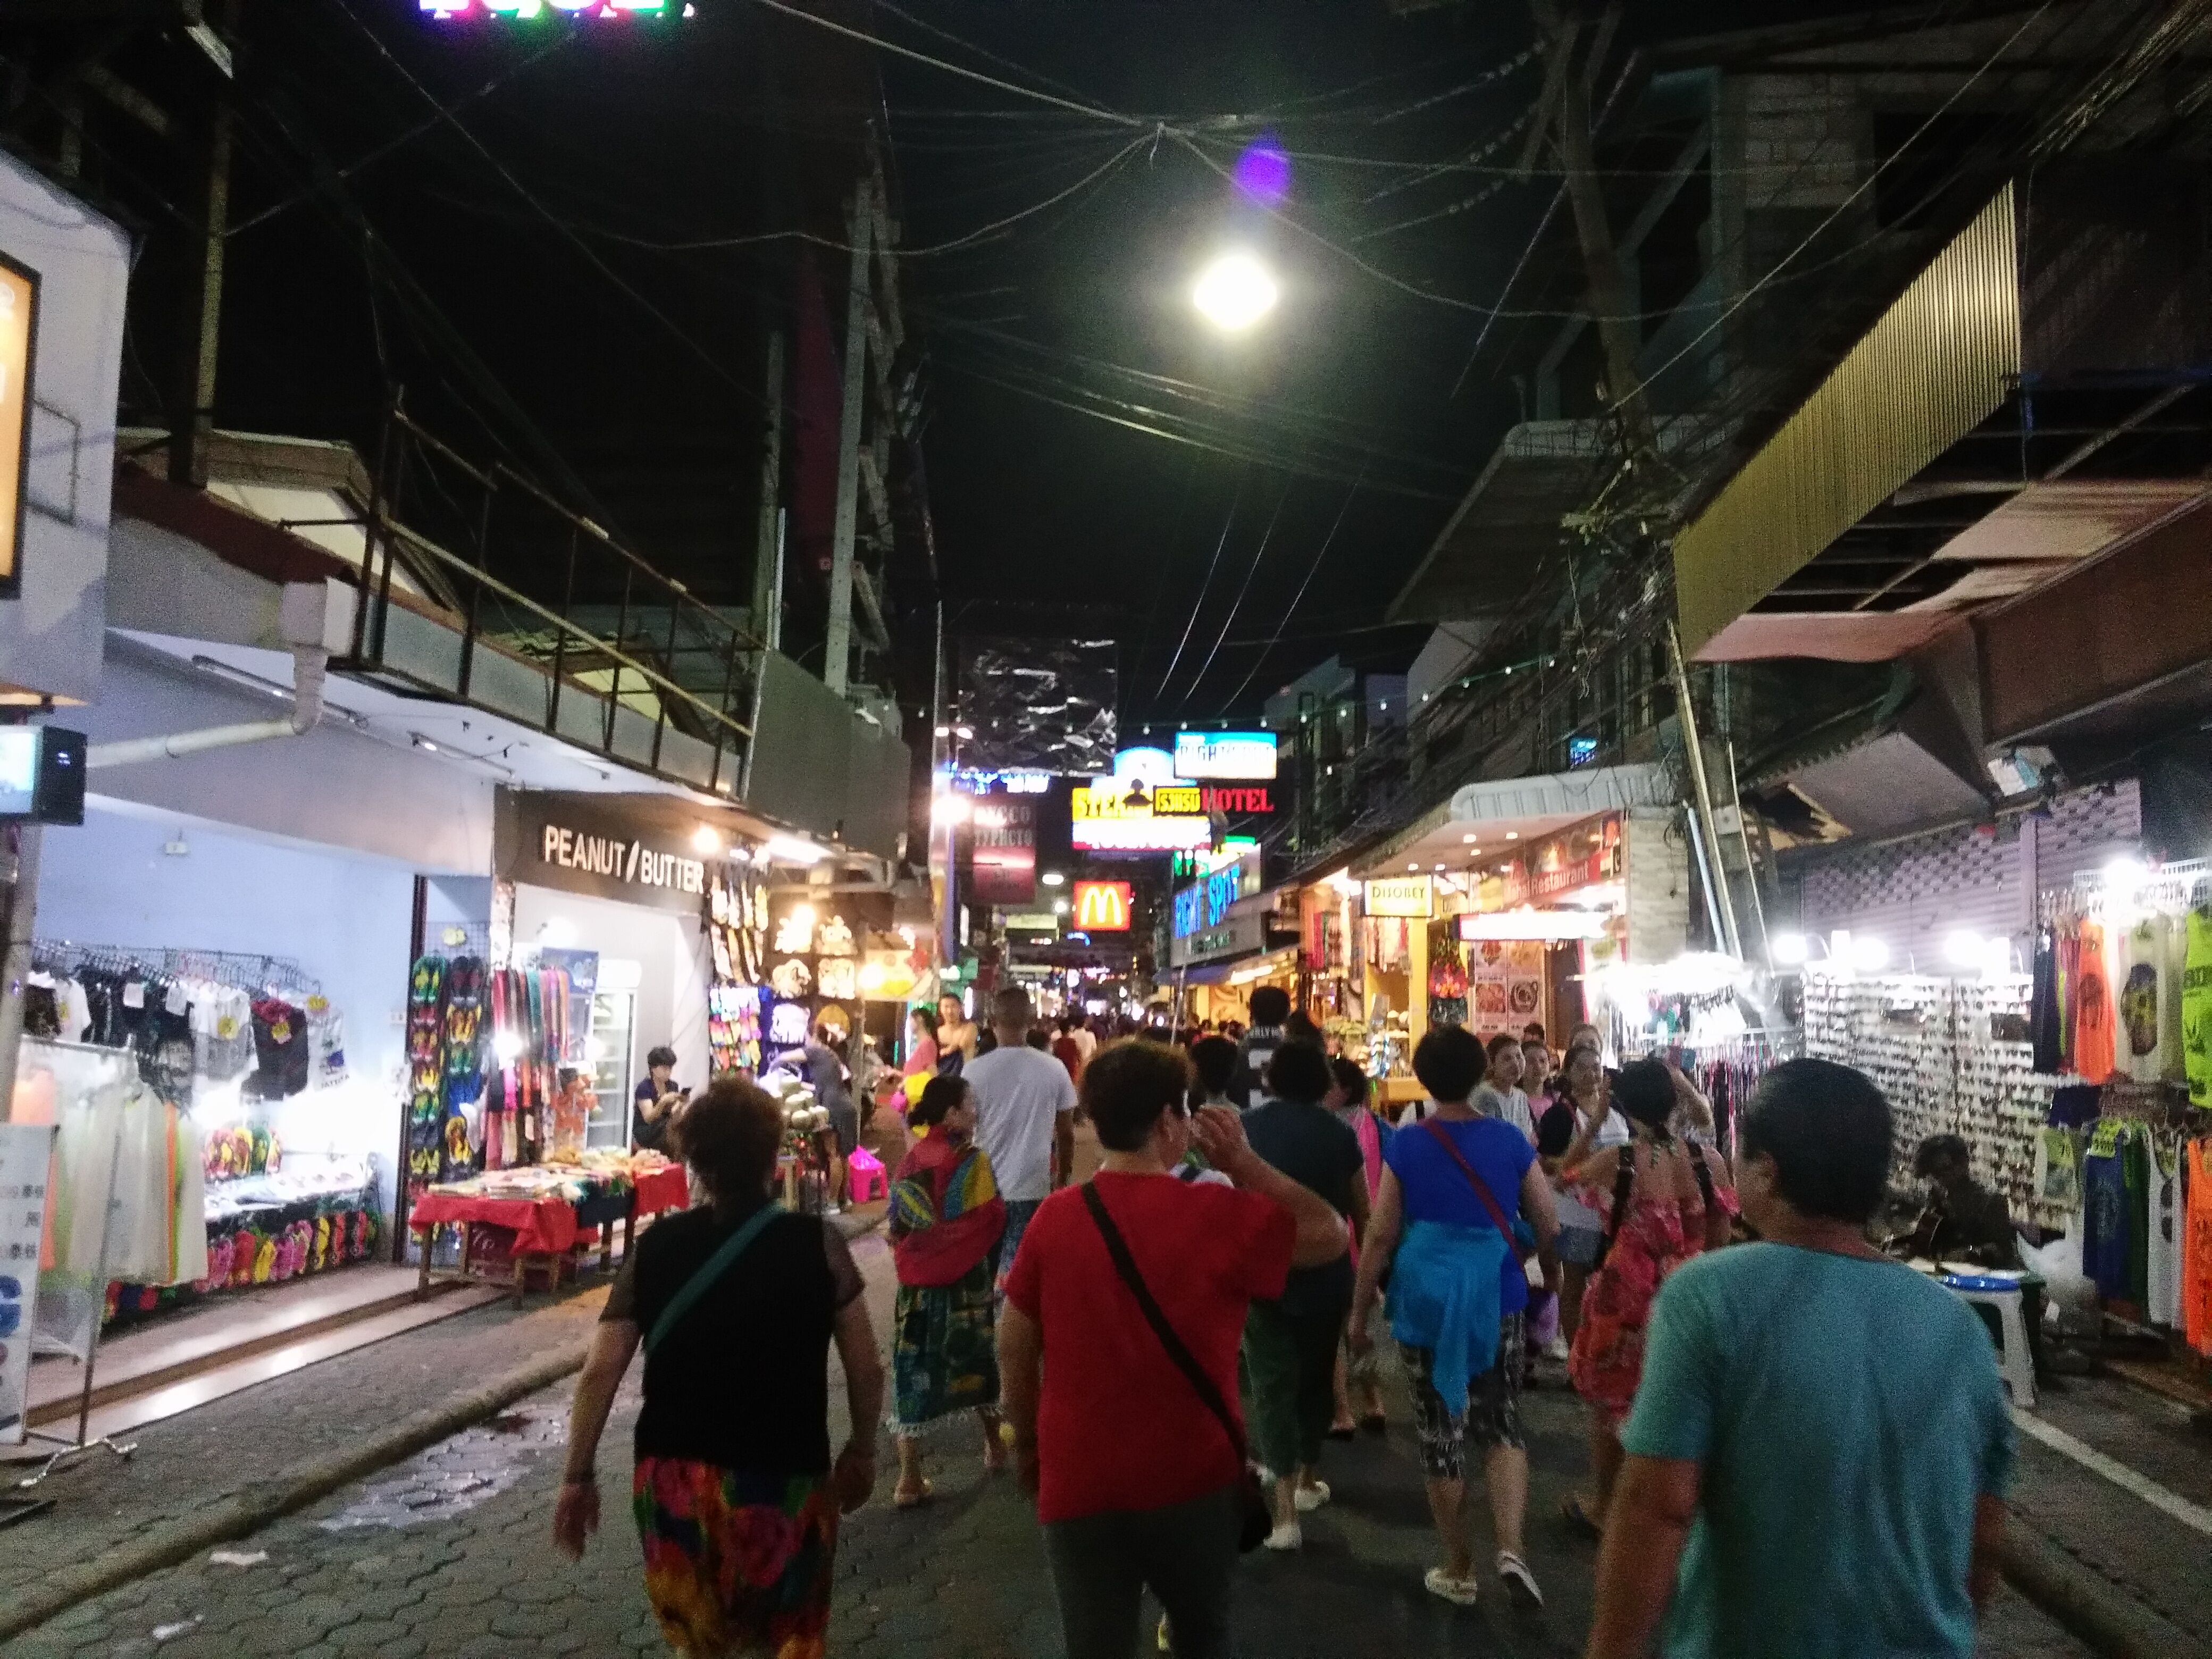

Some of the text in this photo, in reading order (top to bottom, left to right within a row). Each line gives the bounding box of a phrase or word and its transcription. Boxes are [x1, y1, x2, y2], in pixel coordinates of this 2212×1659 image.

[1200, 787, 1275, 812] HOTEL
[544, 824, 705, 894] PEANUT BUTTER
[1531, 859, 1589, 896] Restaurant
[1208, 864, 1240, 927] SPOT
[1372, 886, 1426, 899] DISOBEY
